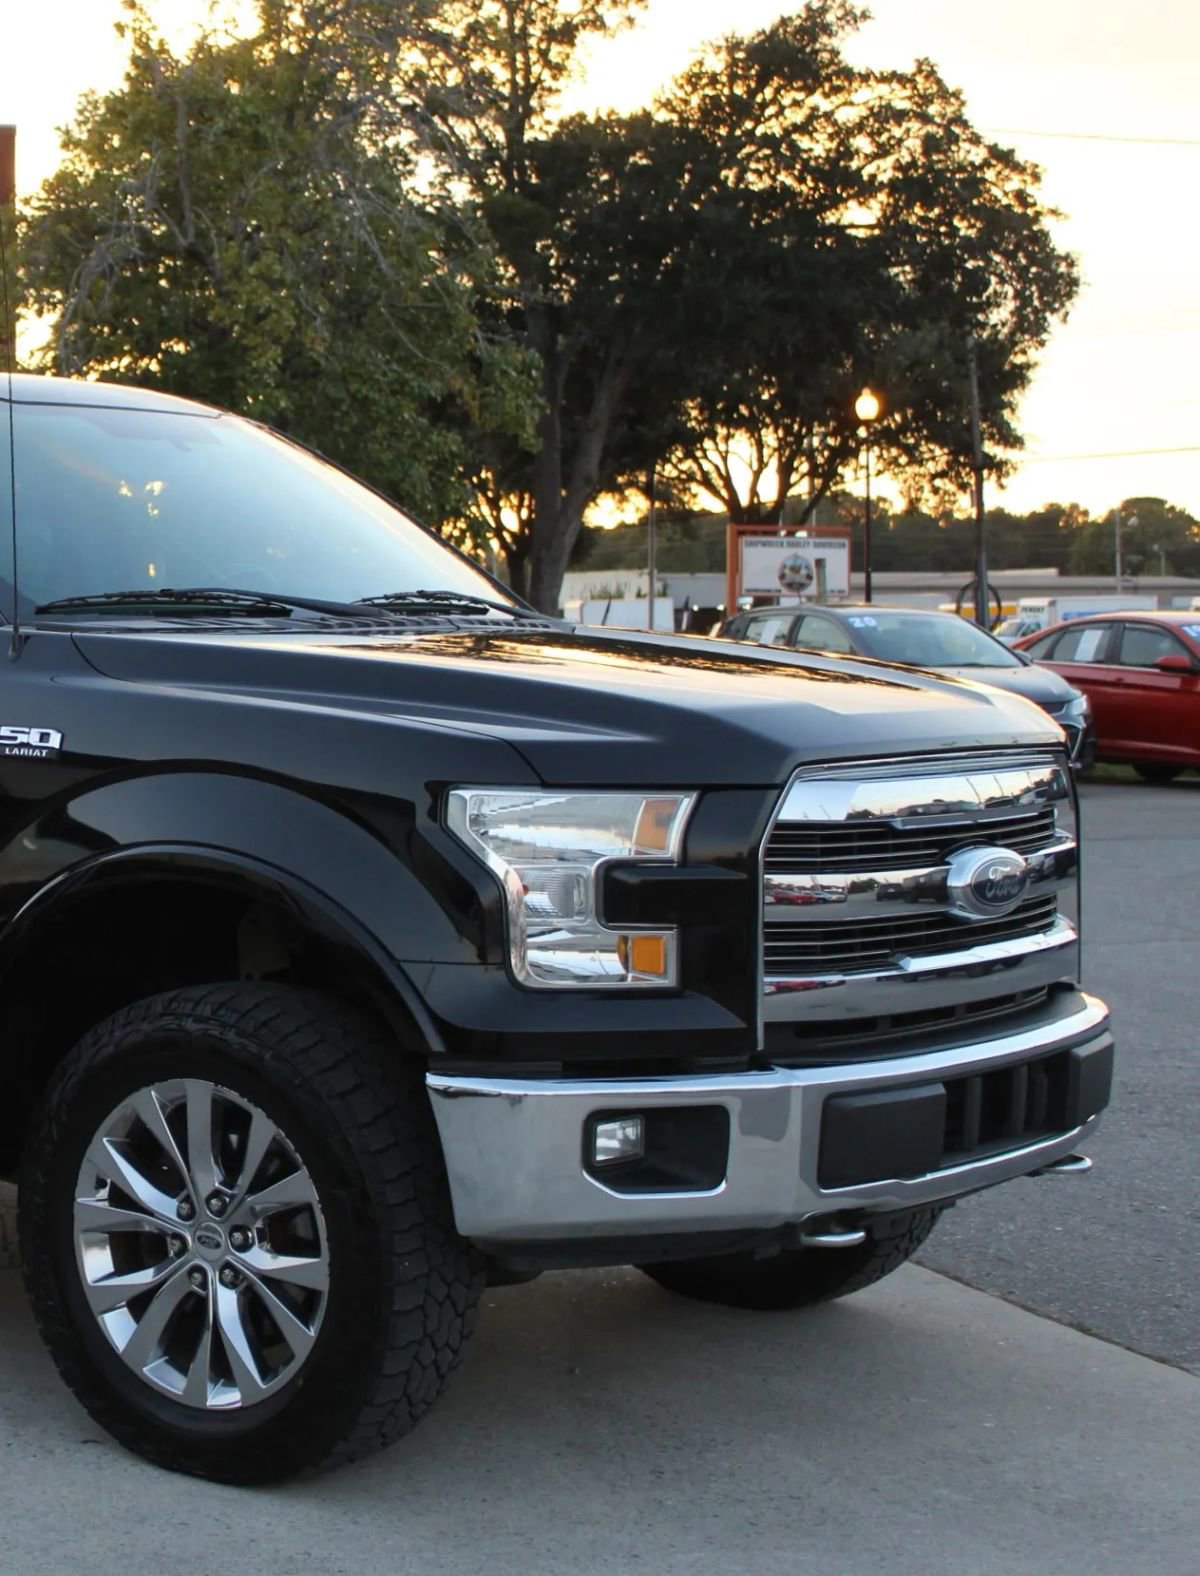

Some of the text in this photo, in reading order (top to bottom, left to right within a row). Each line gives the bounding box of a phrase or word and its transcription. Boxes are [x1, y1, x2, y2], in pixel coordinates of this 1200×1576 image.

[848, 616, 877, 628] 20
[5, 747, 49, 757] LARIAT
[986, 866, 1020, 898] Ford
